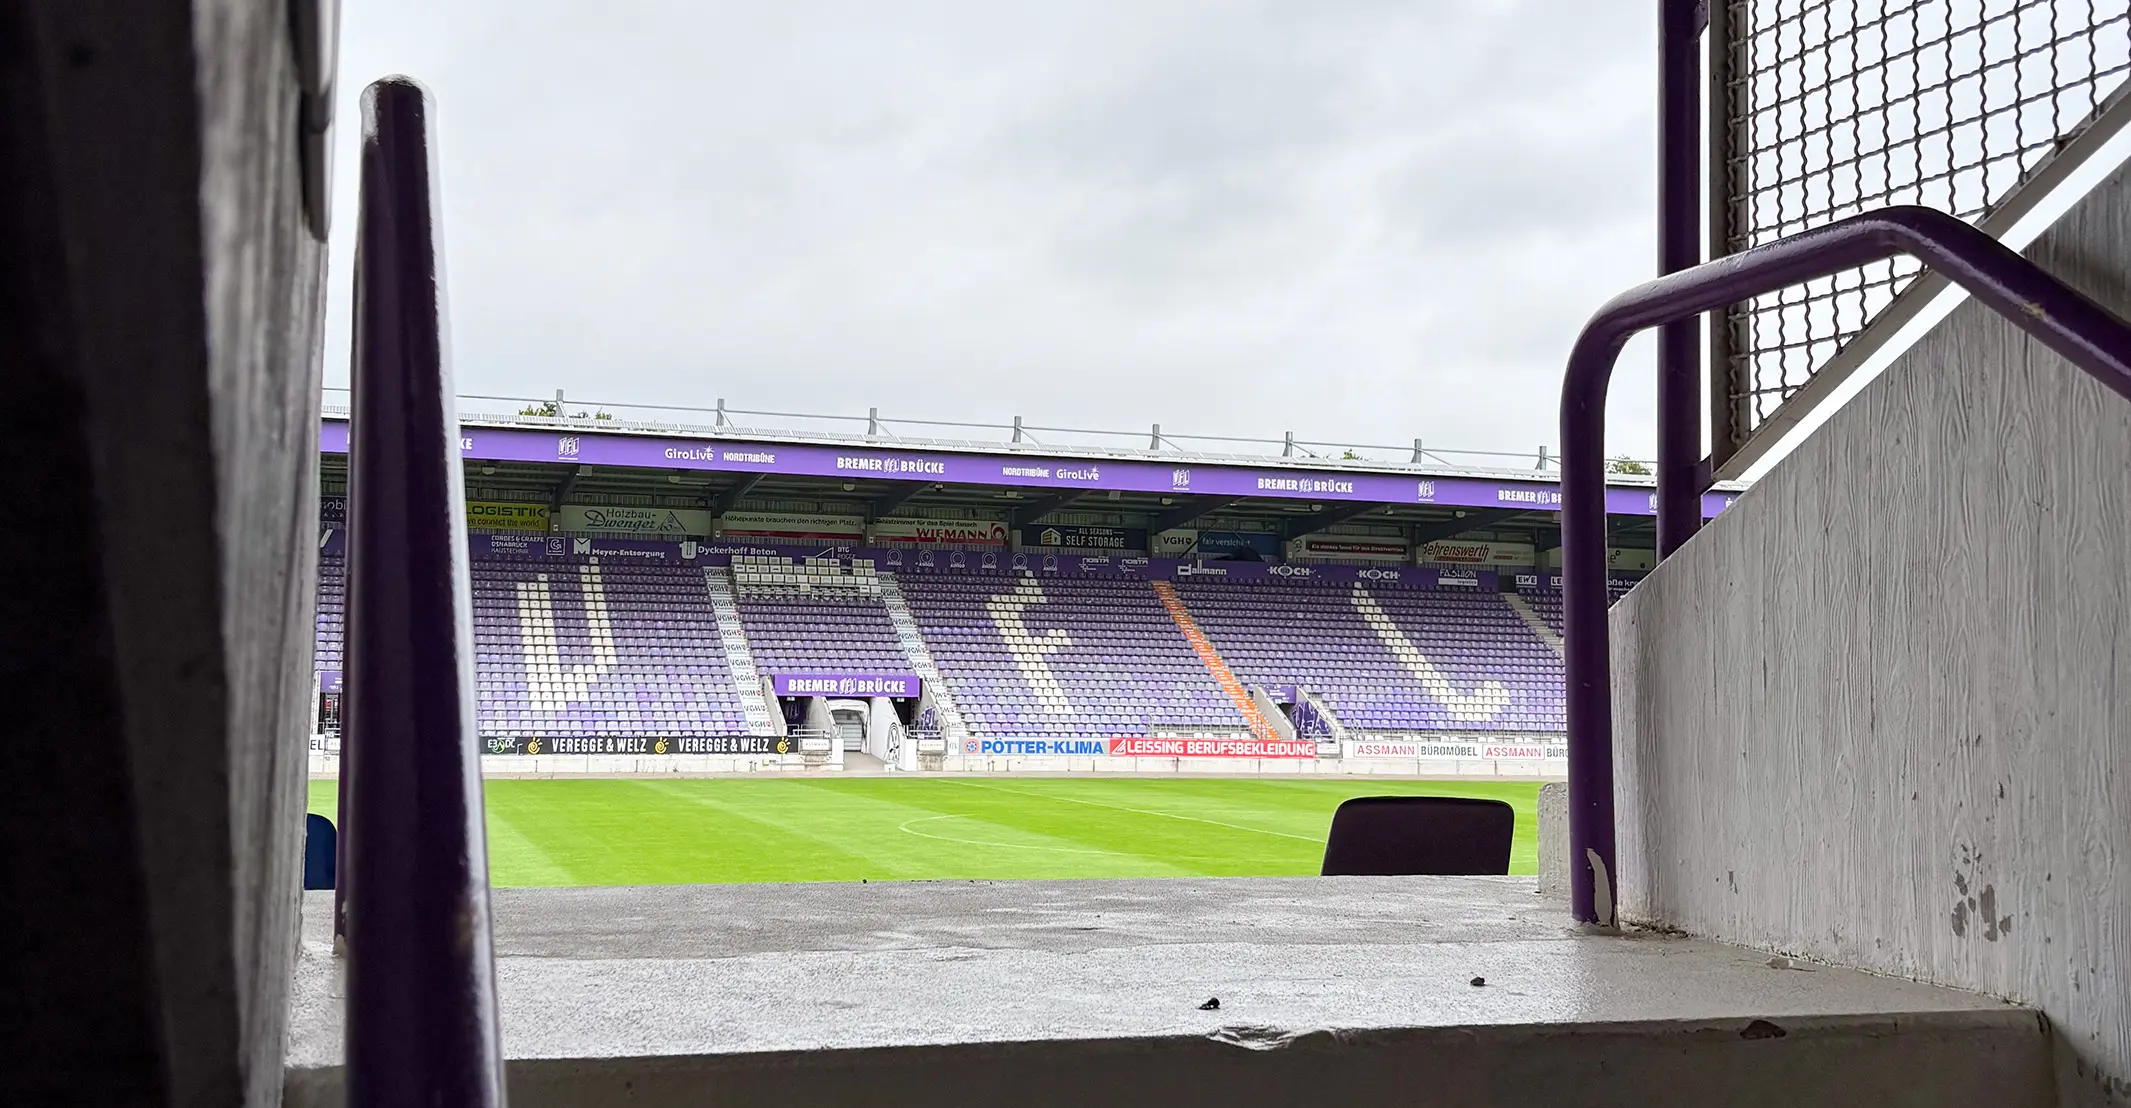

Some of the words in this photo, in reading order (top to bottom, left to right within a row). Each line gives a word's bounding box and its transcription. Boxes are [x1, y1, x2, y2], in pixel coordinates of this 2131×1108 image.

[664, 447, 714, 461] GiroLive
[723, 452, 776, 464] NORDTRIBÜNE
[836, 457, 882, 470] BREMER
[901, 459, 945, 474] BRÜCKE
[1002, 467, 1049, 478] NORDTRIBÜNE
[1056, 467, 1100, 480] GiroLive
[1258, 477, 1298, 491] BREMER
[1314, 479, 1353, 493] BRÜCKE
[1498, 489, 1536, 502] BREMER
[606, 508, 657, 519] Holzbau-
[584, 509, 656, 532] Dwenger
[766, 516, 795, 524] brauchen
[810, 518, 838, 526] richtigen
[916, 527, 988, 540] WIEMANN
[1065, 535, 1086, 546] SELF
[1088, 536, 1125, 548] STORAGE
[1163, 536, 1186, 545] VGH
[1202, 537, 1215, 545] fair
[592, 548, 665, 558] Meyer-Entsorgung
[698, 545, 748, 557] Dyckerhoff
[750, 547, 777, 555] Beton
[1269, 565, 1310, 577] KOCH
[1359, 569, 1399, 579] KOCH
[788, 678, 838, 693] BREMER
[857, 677, 906, 693] BRÜCKE
[552, 738, 603, 752] VEREGGE
[606, 738, 614, 752] &
[617, 738, 647, 752] WELZ
[678, 738, 728, 752] VEREGGE
[730, 738, 738, 752] &
[740, 738, 769, 752] WELZ
[981, 737, 1104, 754] PÖTTER-KLIMA
[1127, 740, 1186, 754] LEISSING
[1188, 741, 1314, 756] BERUFSBEKLEIDUNG
[1357, 744, 1415, 755] ASSMANN
[1421, 744, 1478, 757] BÜROMÖBEL
[1485, 747, 1541, 757] ASSMANN
